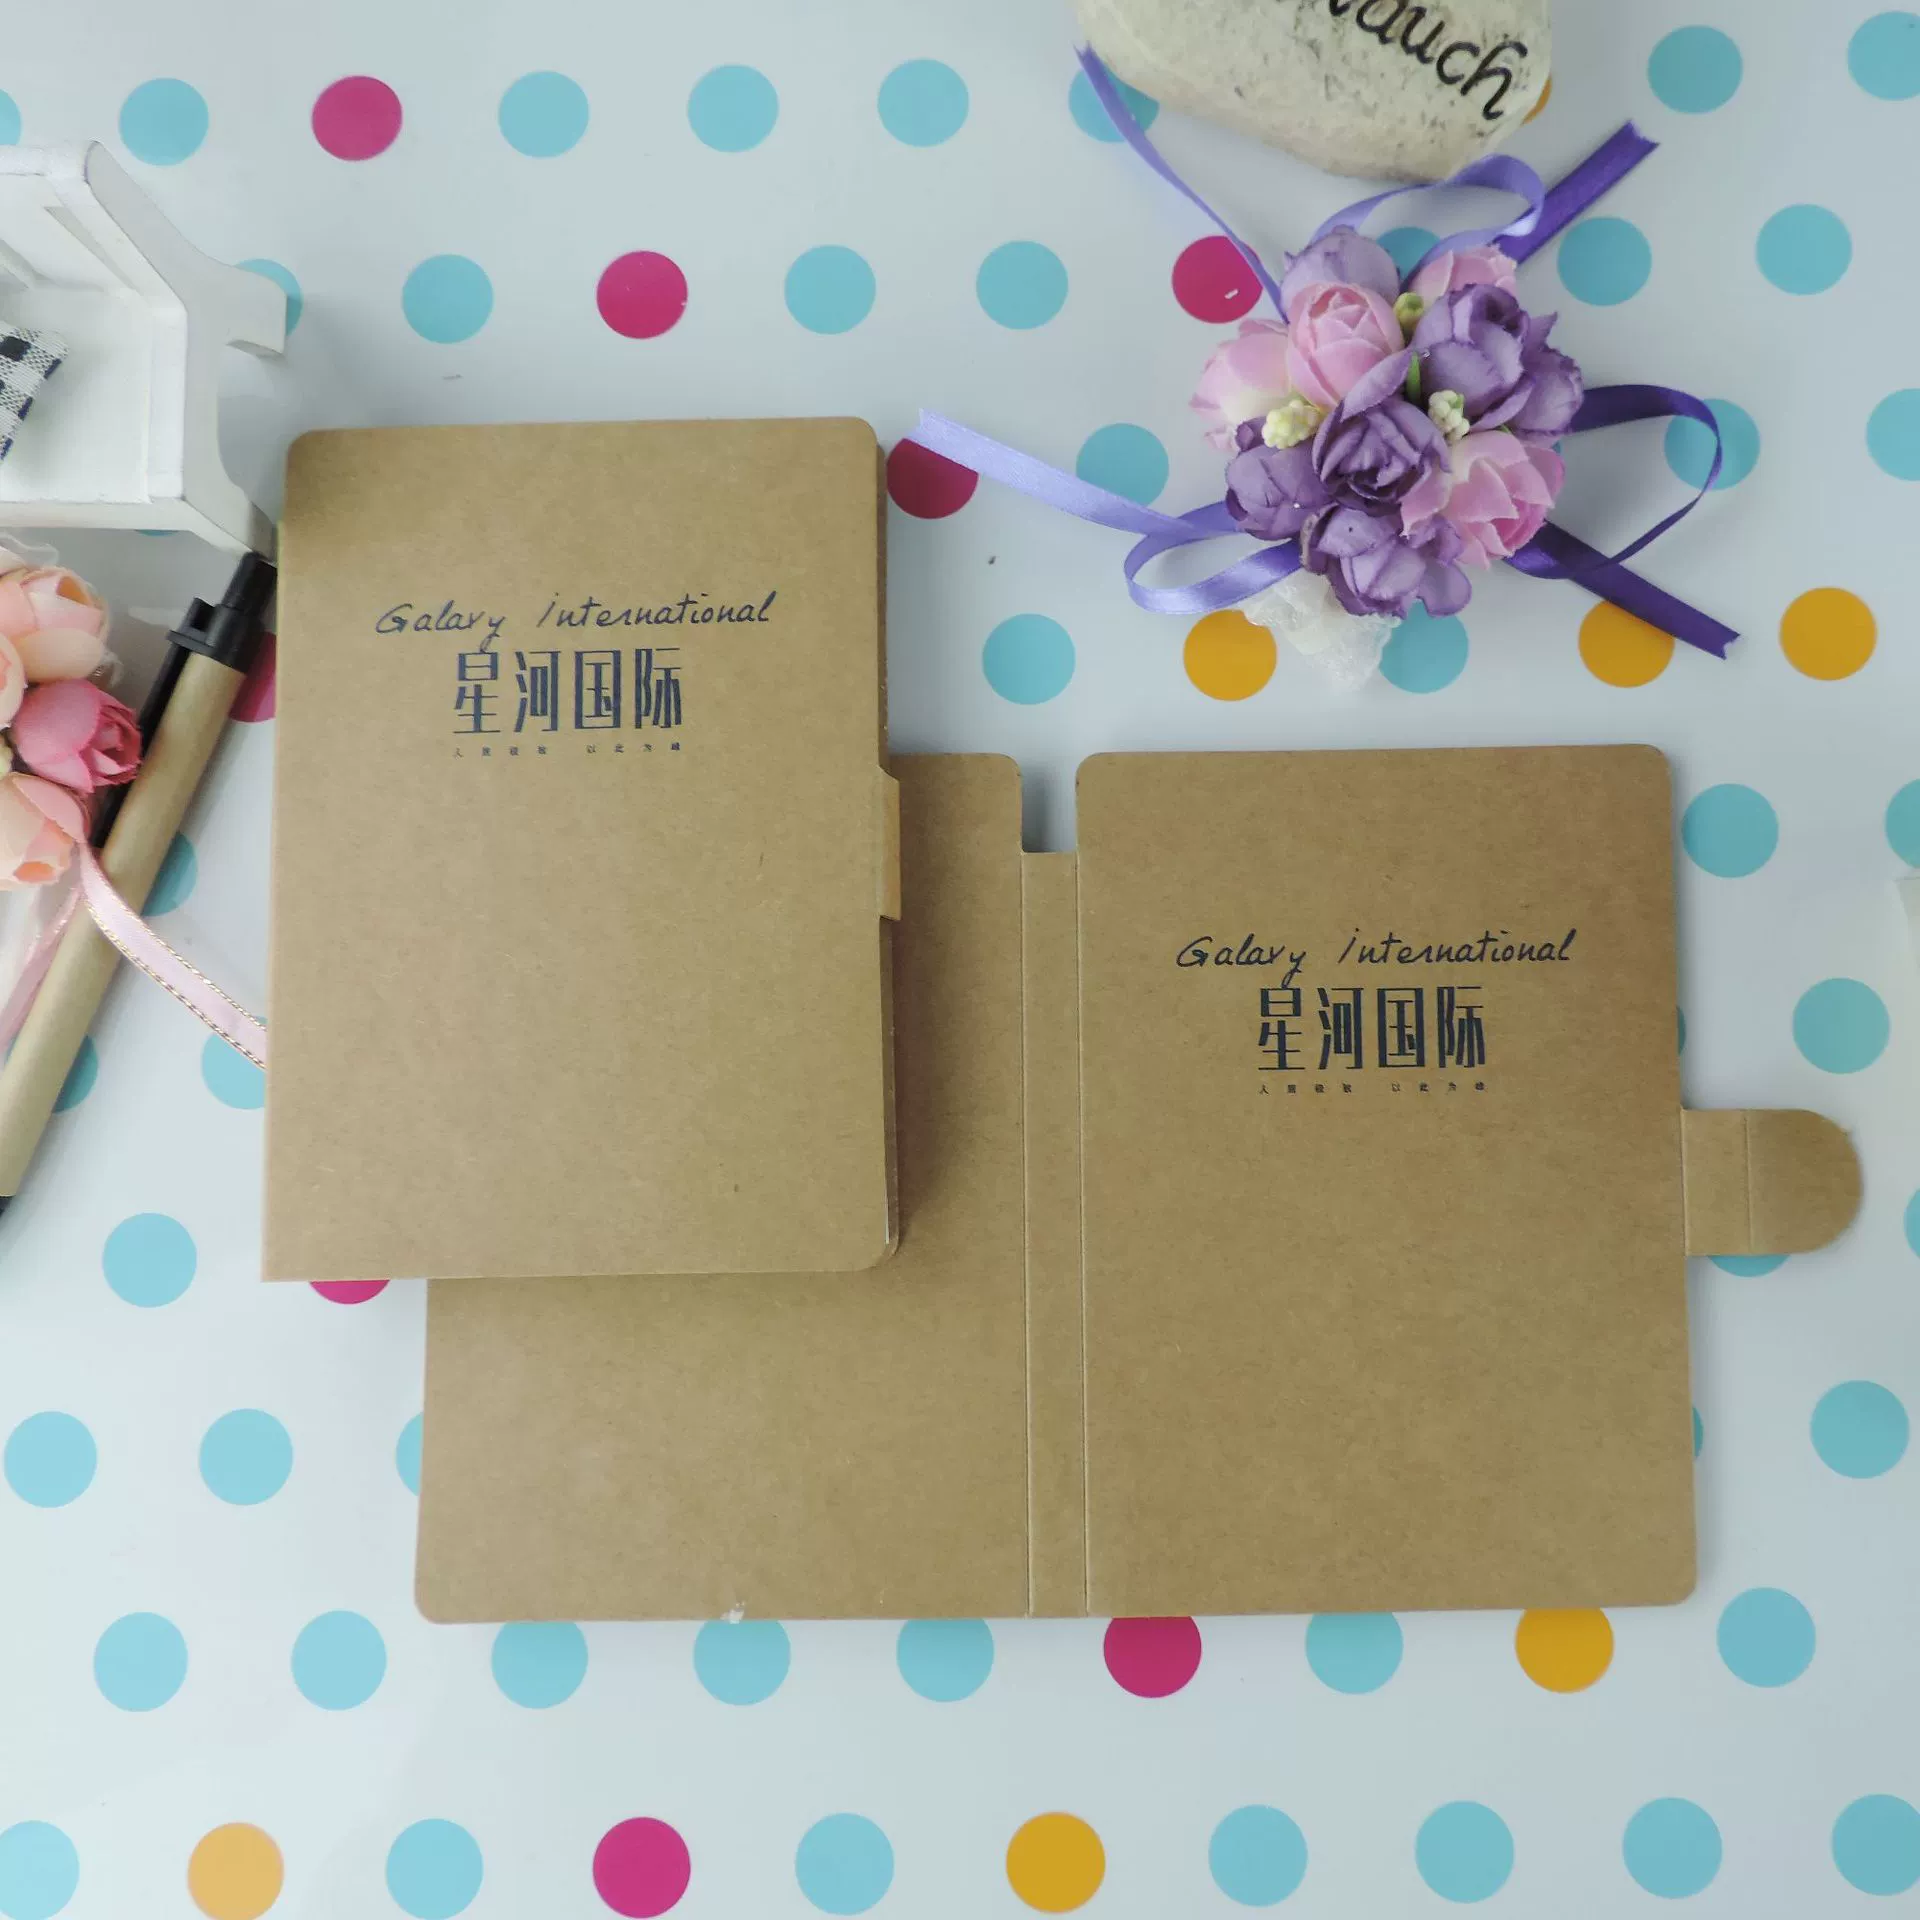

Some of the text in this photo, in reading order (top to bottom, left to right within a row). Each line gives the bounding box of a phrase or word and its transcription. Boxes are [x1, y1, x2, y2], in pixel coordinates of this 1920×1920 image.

[1329, 0, 1529, 120] auch
[453, 647, 683, 734] 星河国际
[1257, 986, 1486, 1071] 星河国际
